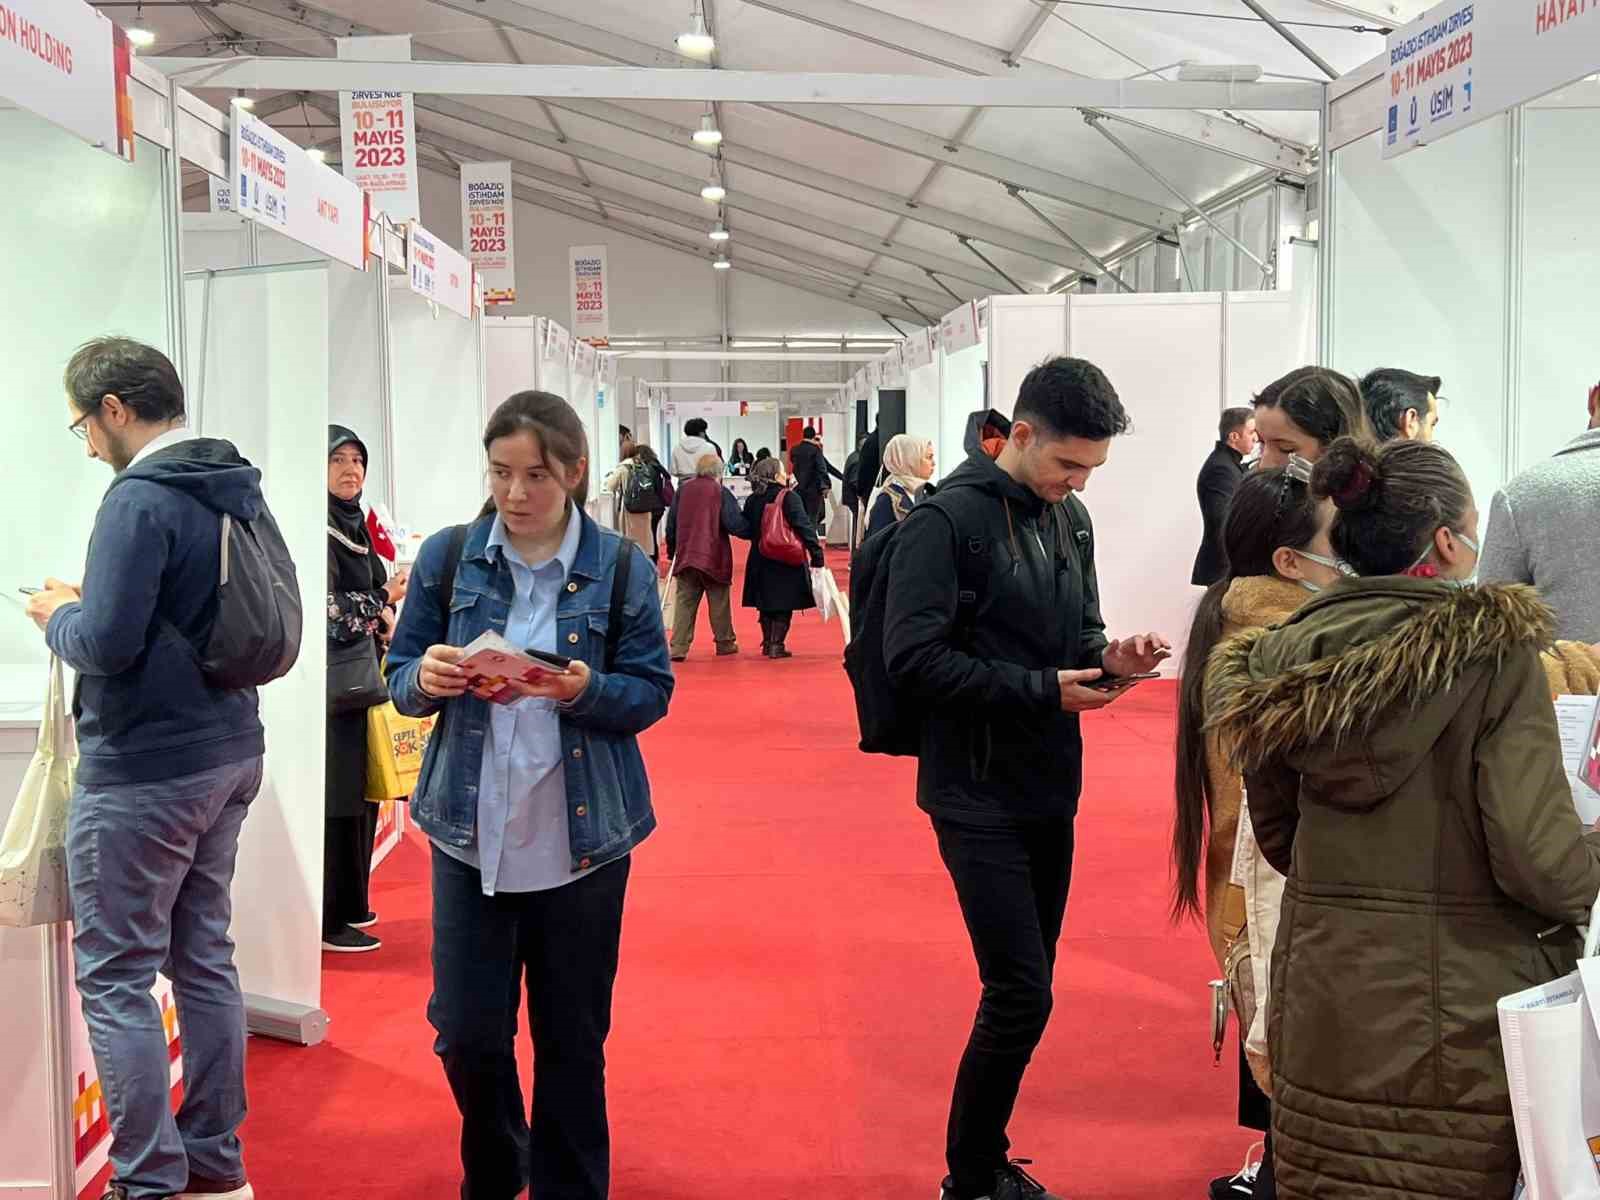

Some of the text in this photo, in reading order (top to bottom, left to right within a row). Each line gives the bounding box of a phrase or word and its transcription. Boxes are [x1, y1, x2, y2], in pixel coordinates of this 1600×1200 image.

[1417, 48, 1446, 85] MAYIS
[1447, 32, 1473, 69] 2023
[354, 130, 405, 146] MAYIS
[355, 147, 406, 168] 2023
[470, 226, 505, 238] MAYIS
[471, 239, 506, 252] 2023
[577, 300, 603, 310] 2023
